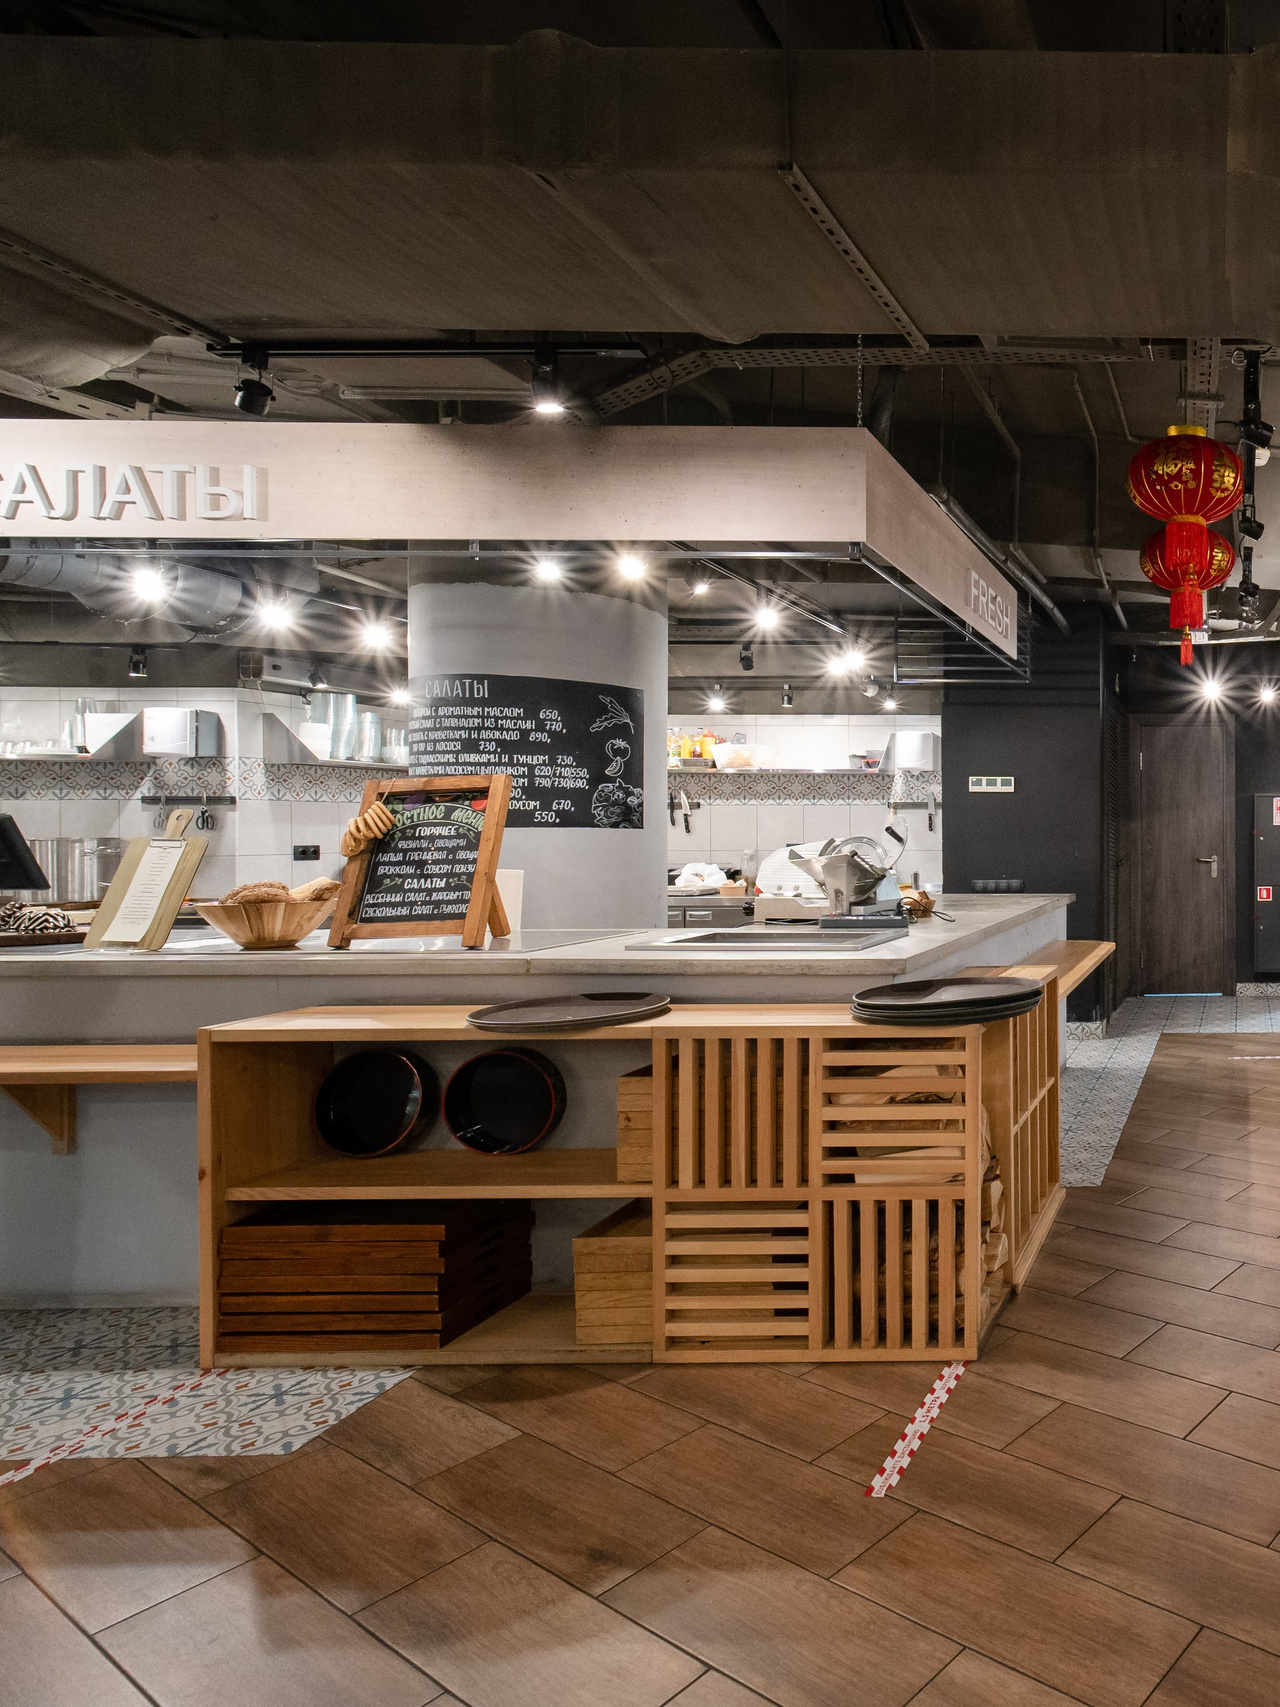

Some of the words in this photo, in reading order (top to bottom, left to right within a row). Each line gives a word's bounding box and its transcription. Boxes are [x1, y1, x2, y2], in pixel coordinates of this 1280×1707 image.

[0, 463, 262, 521] АЛАТЫ
[971, 570, 1011, 640] FRESH
[425, 679, 489, 698] САЛАТЫ
[437, 706, 482, 717] АРОМАТНЫМ
[484, 707, 524, 718] МАСЛОМ
[539, 708, 562, 721] 650,
[484, 718, 495, 728] ИЗ
[498, 719, 535, 730] МАСЛИН
[471, 730, 478, 739] И
[480, 730, 520, 740] АВОКАДО
[426, 742, 434, 751] ИЗ
[435, 741, 461, 751] ЛОСОСЯ
[502, 754, 509, 763] И
[512, 754, 549, 765] ТУНЦОМ
[510, 788, 526, 799] 90,
[509, 801, 540, 810] ОУСОМ
[552, 800, 575, 812] 670,
[395, 804, 446, 827] ОСТНОЕ
[534, 811, 560, 823] 550,
[415, 825, 459, 837] ГОРЯЧЕЕ
[434, 838, 467, 848] ОВОЩАМИ
[376, 853, 403, 862] ЛАПША
[405, 851, 447, 861] ГРЕЧНЕВАЯ
[455, 850, 478, 860] ОВОЩА
[377, 865, 416, 876] БРОККОЛИ
[423, 864, 452, 875] СОУСОМ
[452, 864, 476, 873] ПОНЗУ
[404, 878, 447, 889] САЛАТЫ
[364, 891, 403, 904] ВЕСЕННИЙ
[404, 892, 427, 902] САЛАТ
[362, 905, 410, 918] СВЕКОЛЬНЫЙ
[412, 905, 434, 914] САЛАТ
